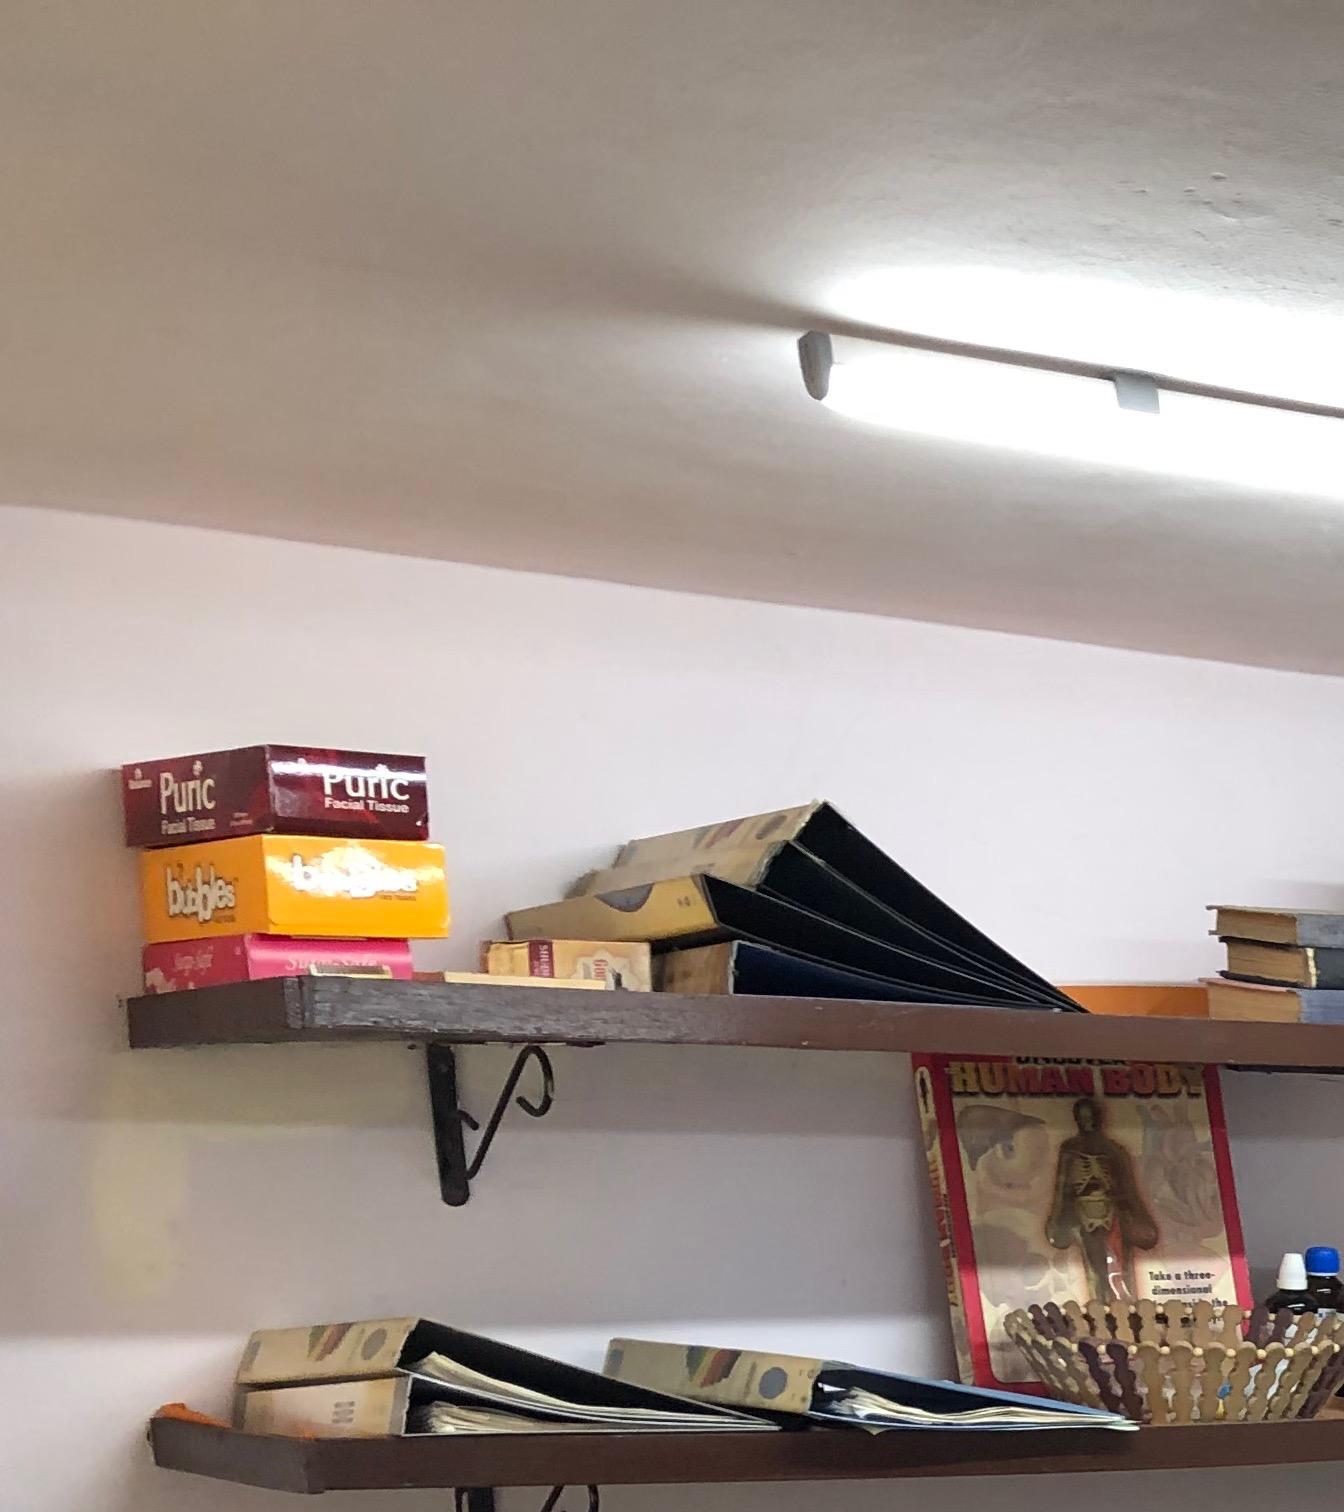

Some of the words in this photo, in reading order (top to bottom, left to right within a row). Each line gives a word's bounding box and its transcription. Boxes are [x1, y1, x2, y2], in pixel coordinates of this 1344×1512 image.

[160, 771, 216, 815] Puric
[322, 770, 410, 801] Puric
[324, 798, 365, 811] Facial
[368, 801, 410, 815] Tissue
[161, 819, 185, 835] Facial
[186, 816, 217, 833] Tissue
[166, 863, 236, 922] bubbles
[950, 1062, 1096, 1096] HUMAN
[1103, 1064, 1203, 1097] BODY
[1148, 1270, 1172, 1280] Take
[1183, 1269, 1216, 1280] three-
[1151, 1283, 1213, 1295] dimensional
